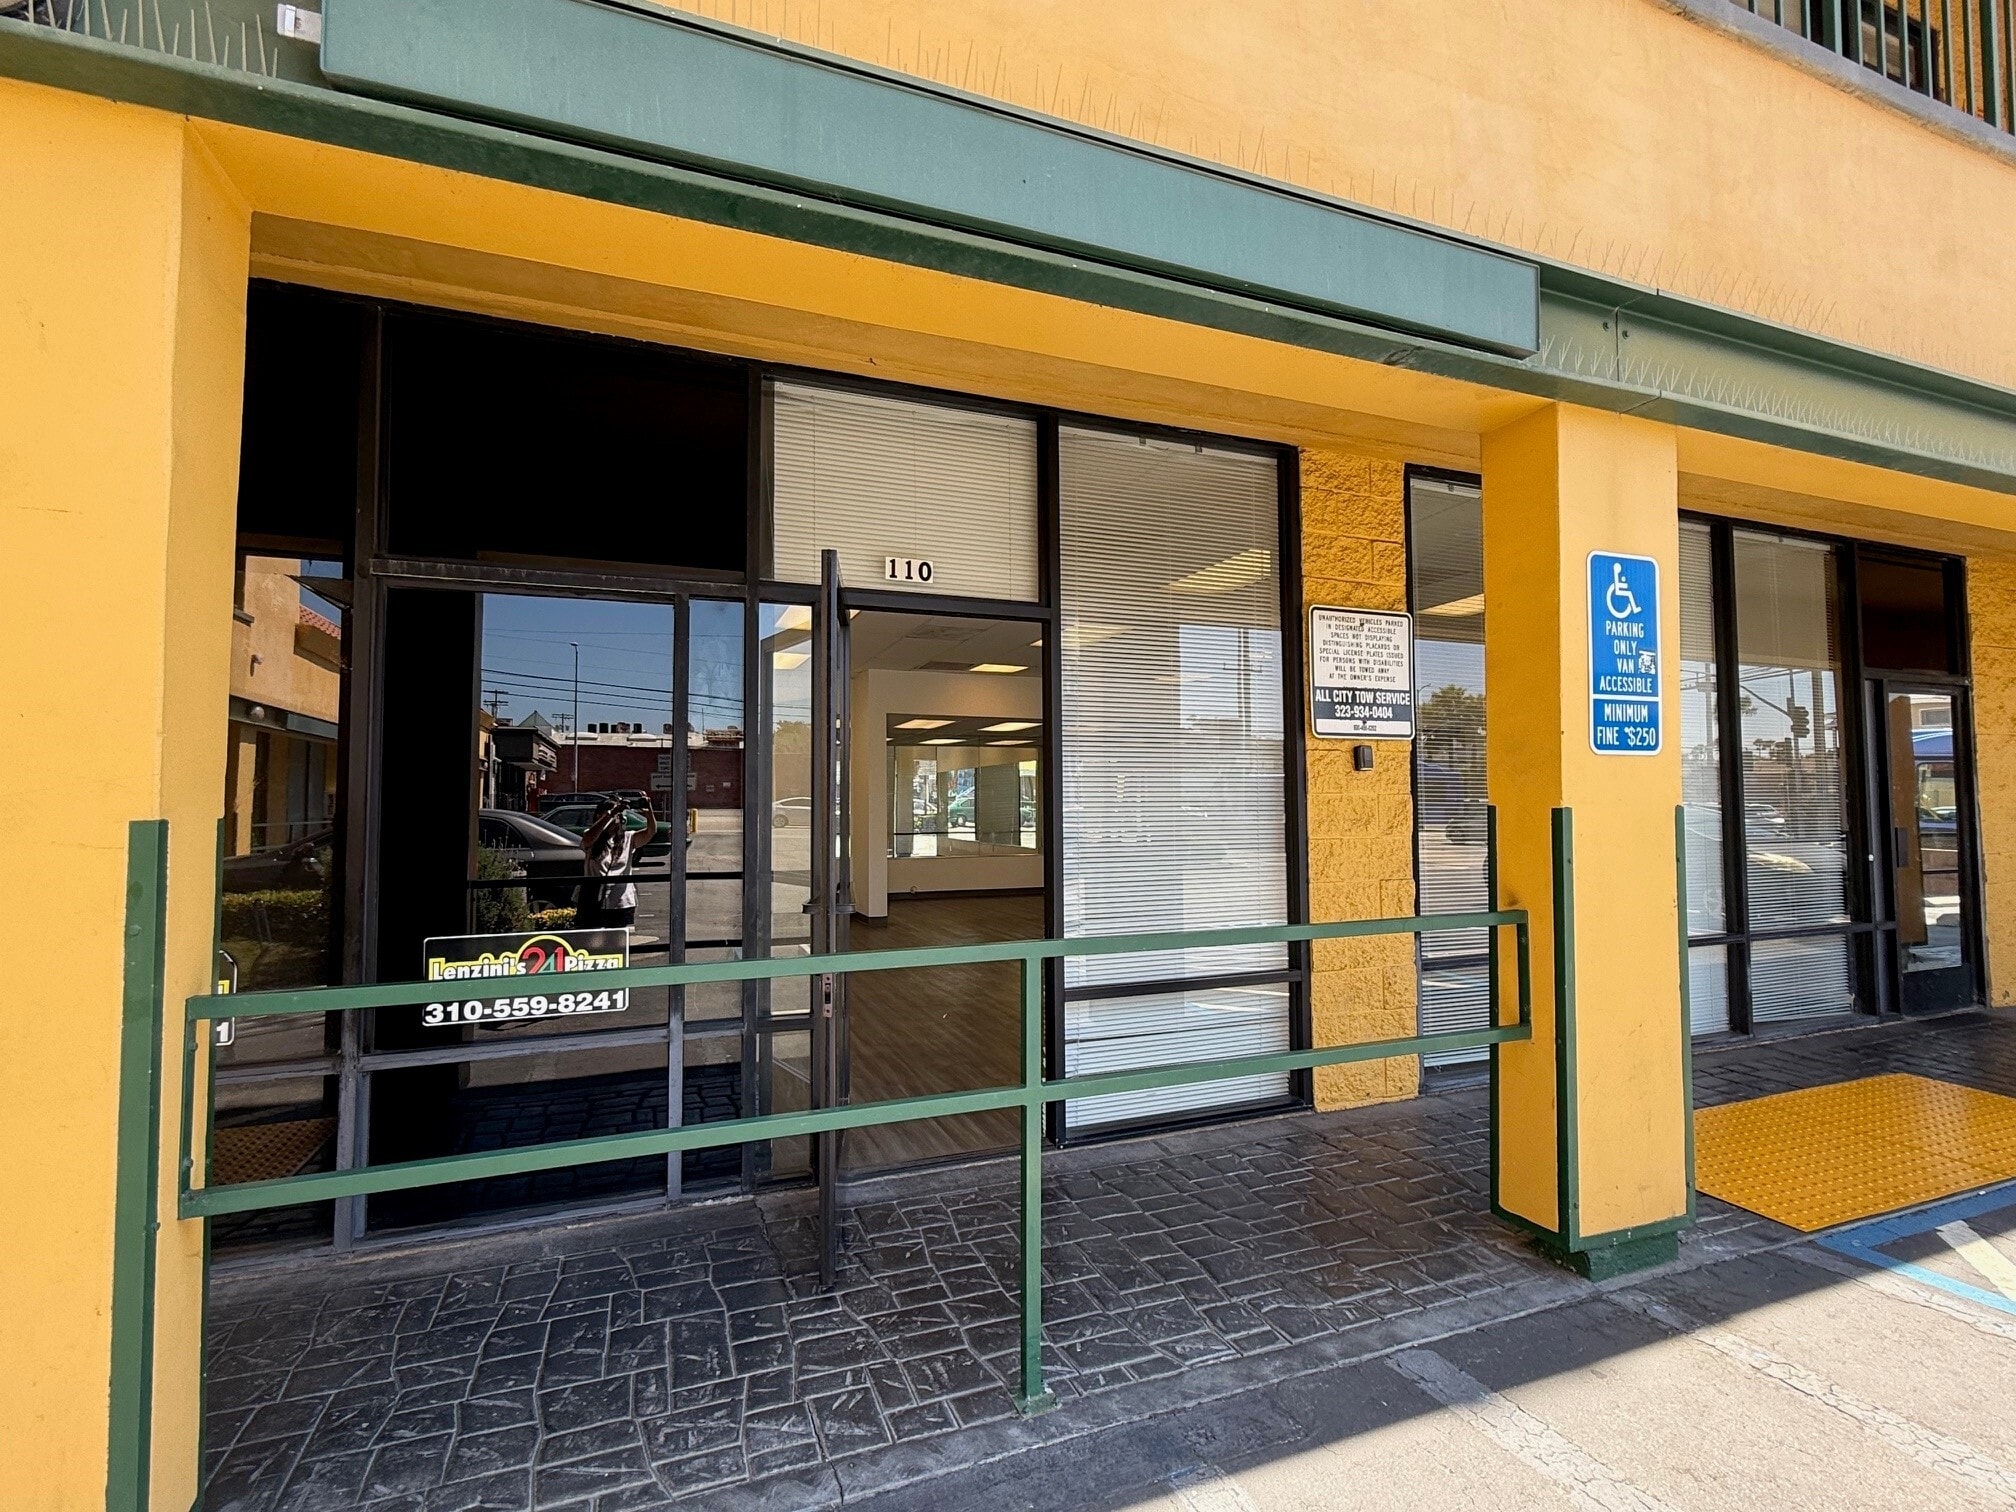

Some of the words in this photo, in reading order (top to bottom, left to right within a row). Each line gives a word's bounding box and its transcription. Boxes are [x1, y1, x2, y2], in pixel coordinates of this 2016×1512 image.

[889, 558, 932, 582] 110
[1318, 614, 1356, 624] UNAUTHORIZED
[1359, 617, 1383, 626] VEHICLES
[1385, 620, 1404, 628] PARKED
[1605, 620, 1644, 638] PARKING
[1330, 632, 1350, 640] SPACES
[1365, 634, 1393, 642] DISPLAYING
[1335, 624, 1365, 632] DESIGNATED
[1368, 626, 1397, 635] ACCESSIBLE
[1322, 640, 1363, 648] DISTINGUISHING
[1366, 642, 1391, 650] PLACARDS
[1614, 640, 1638, 656] ONLY
[1333, 656, 1356, 664] PERSONS
[1616, 658, 1634, 674] VAN
[1350, 674, 1372, 682] OWNER'S
[1360, 666, 1375, 674] TOWED
[1600, 676, 1653, 693] ACCESSIBLE
[1316, 688, 1332, 702] ALL
[1333, 690, 1353, 703] CITY
[1354, 690, 1374, 704] TOW
[1376, 692, 1410, 706] SERVICE
[1334, 704, 1393, 719] 323-934-0404
[1604, 703, 1648, 723] MINIMUM
[1597, 726, 1620, 746] FINE
[1627, 726, 1656, 748] $250
[432, 956, 527, 980] Lenzini's
[564, 954, 619, 972] Pizza
[425, 990, 624, 1024] 310-559-8241
